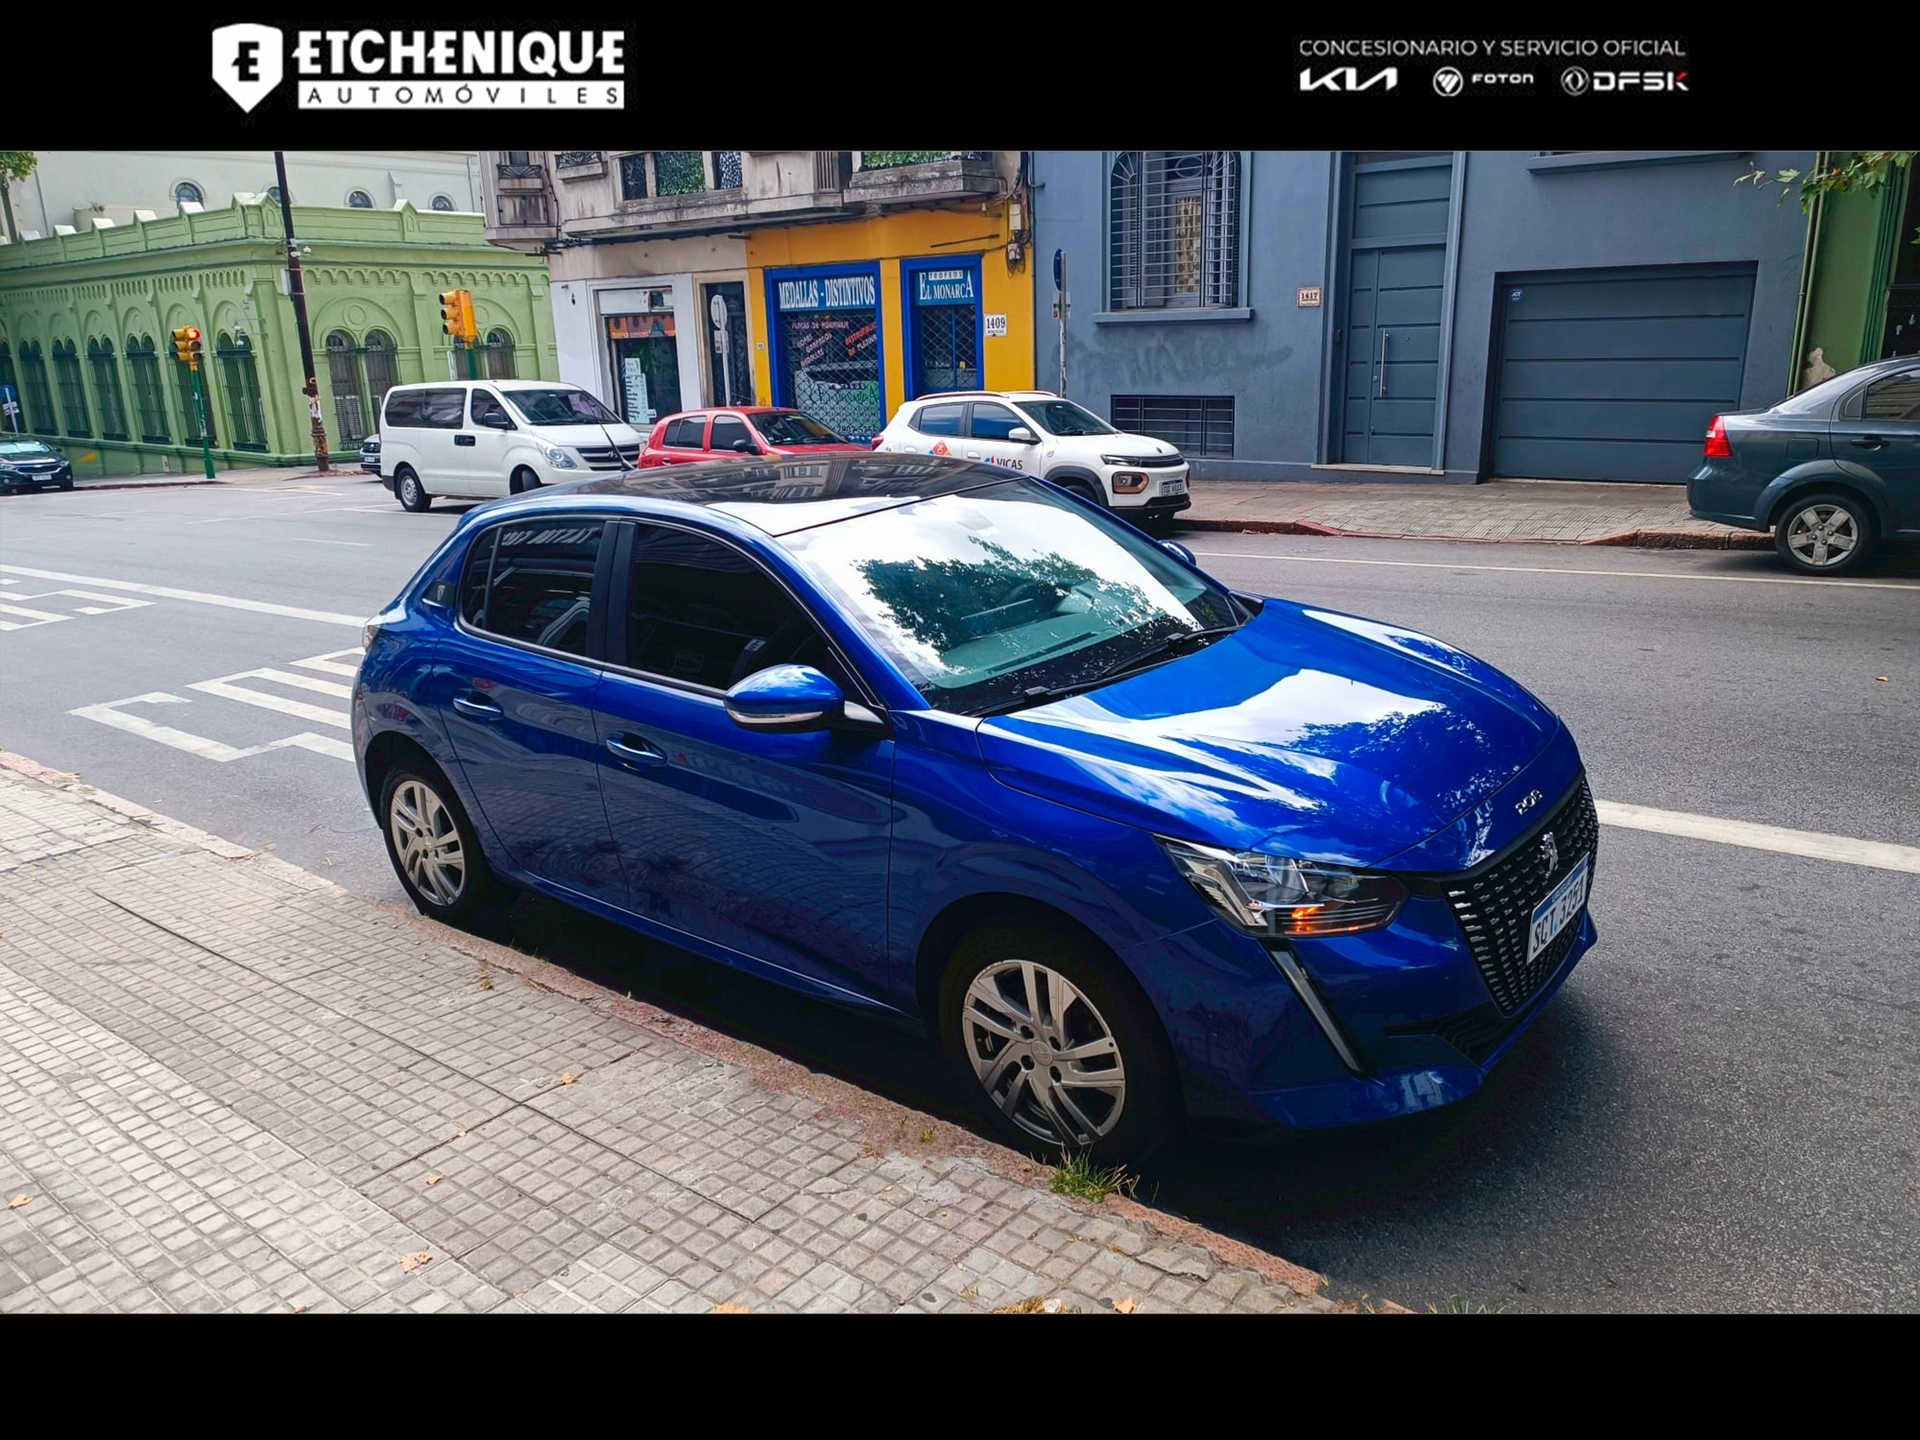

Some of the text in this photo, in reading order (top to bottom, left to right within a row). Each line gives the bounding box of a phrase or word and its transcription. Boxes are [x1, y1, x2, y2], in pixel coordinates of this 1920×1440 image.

[929, 270, 963, 280] TROFEOS
[933, 269, 975, 301] MONARCA
[778, 279, 819, 310] MEDALLAS
[824, 275, 876, 308] DISTINTIVOS
[1301, 292, 1318, 300] 1417
[986, 317, 1006, 329] 1409
[1532, 875, 1585, 954] SCT 3251
